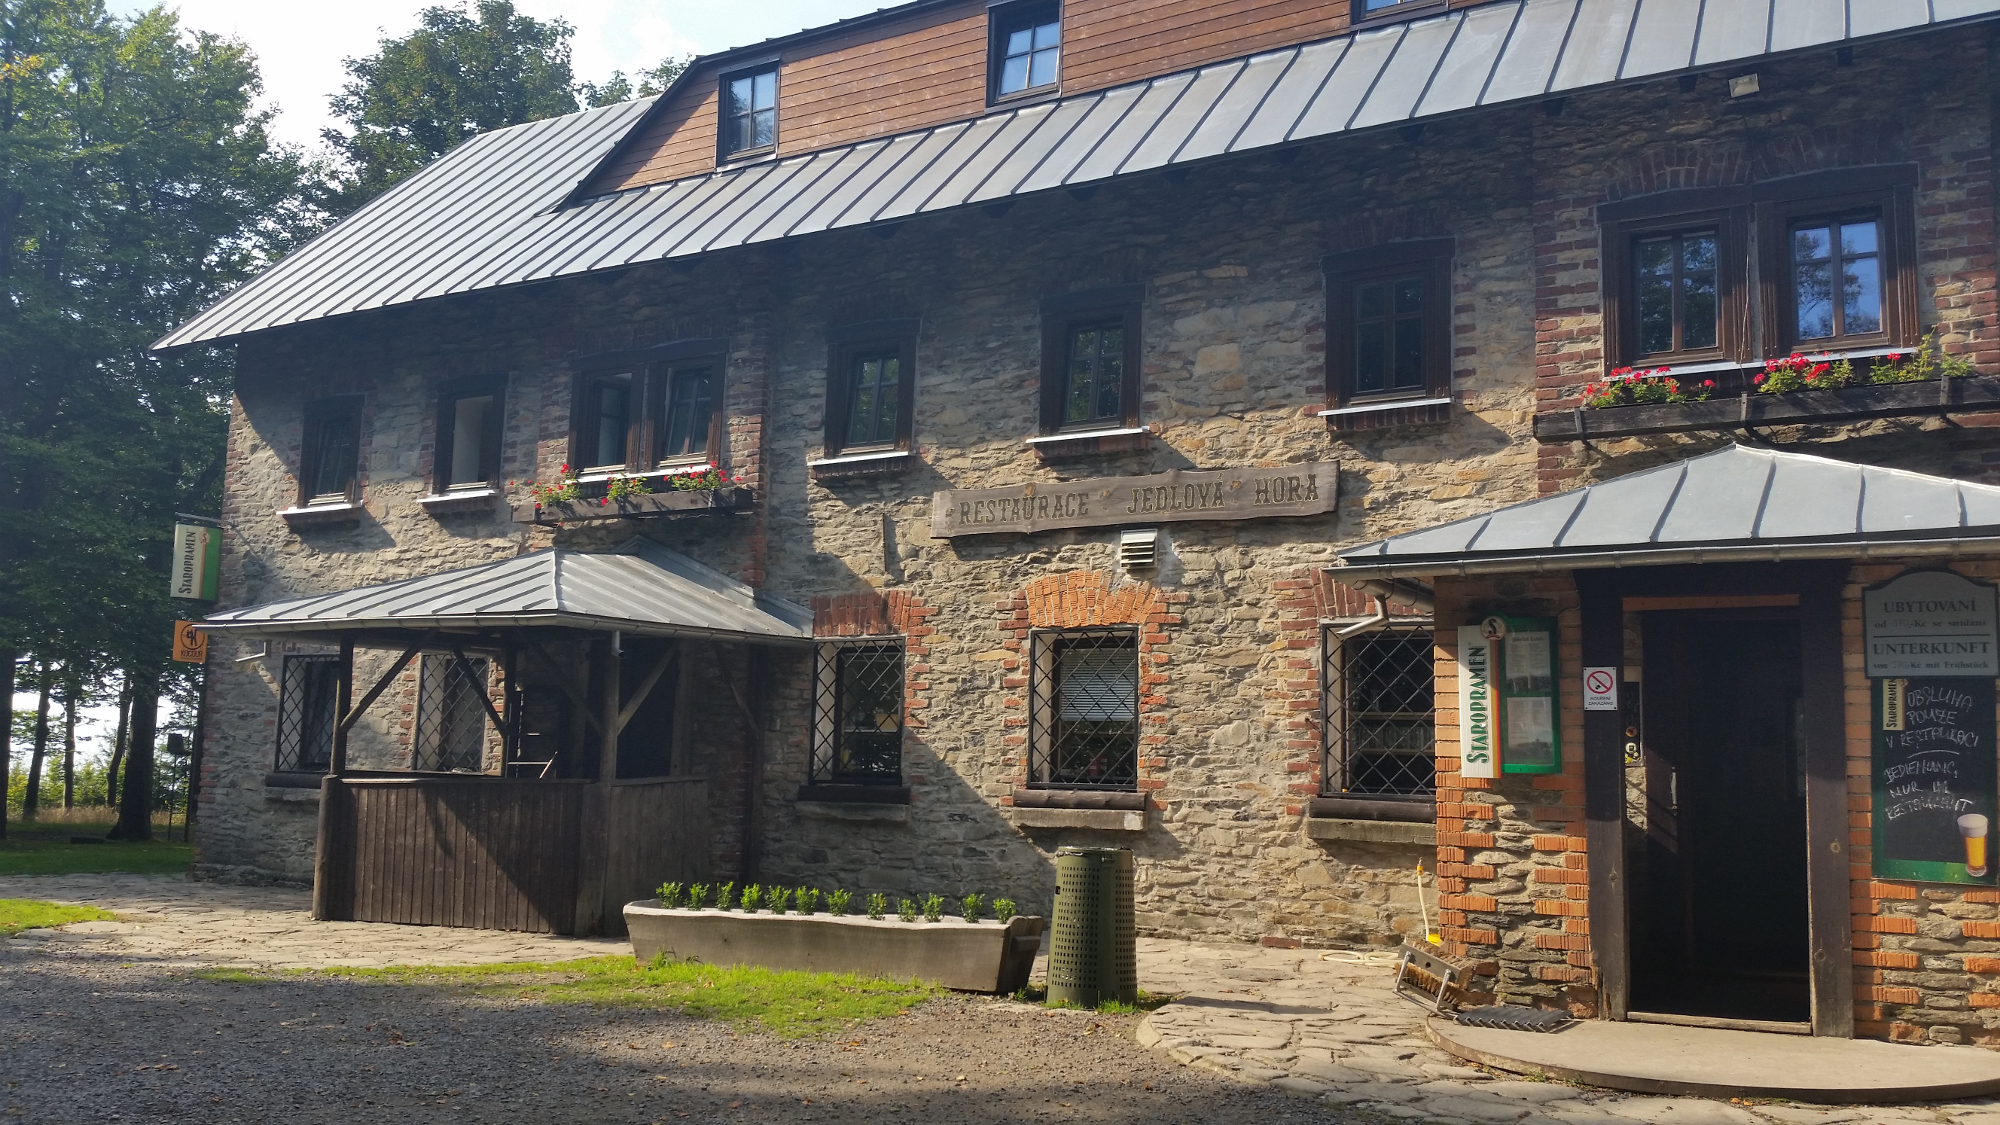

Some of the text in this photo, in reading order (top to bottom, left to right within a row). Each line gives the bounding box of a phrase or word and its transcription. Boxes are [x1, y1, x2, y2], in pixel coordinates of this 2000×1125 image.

[958, 473, 1321, 526] RESTAURACE JEDLOVÁ HORA
[178, 531, 196, 595] STAROPRAMEN
[1884, 597, 1977, 614] UBYTOVÁNÍ
[1873, 641, 1990, 655] UNTERKUNFT
[1925, 661, 1940, 669] mit
[1466, 645, 1490, 764] STAROPRAMEN
[1907, 686, 1973, 713] OBSLUHA
[1906, 708, 1958, 725] POUZE
[1885, 727, 1980, 749] V RESTAURACI
[1889, 780, 1924, 799] NUR
